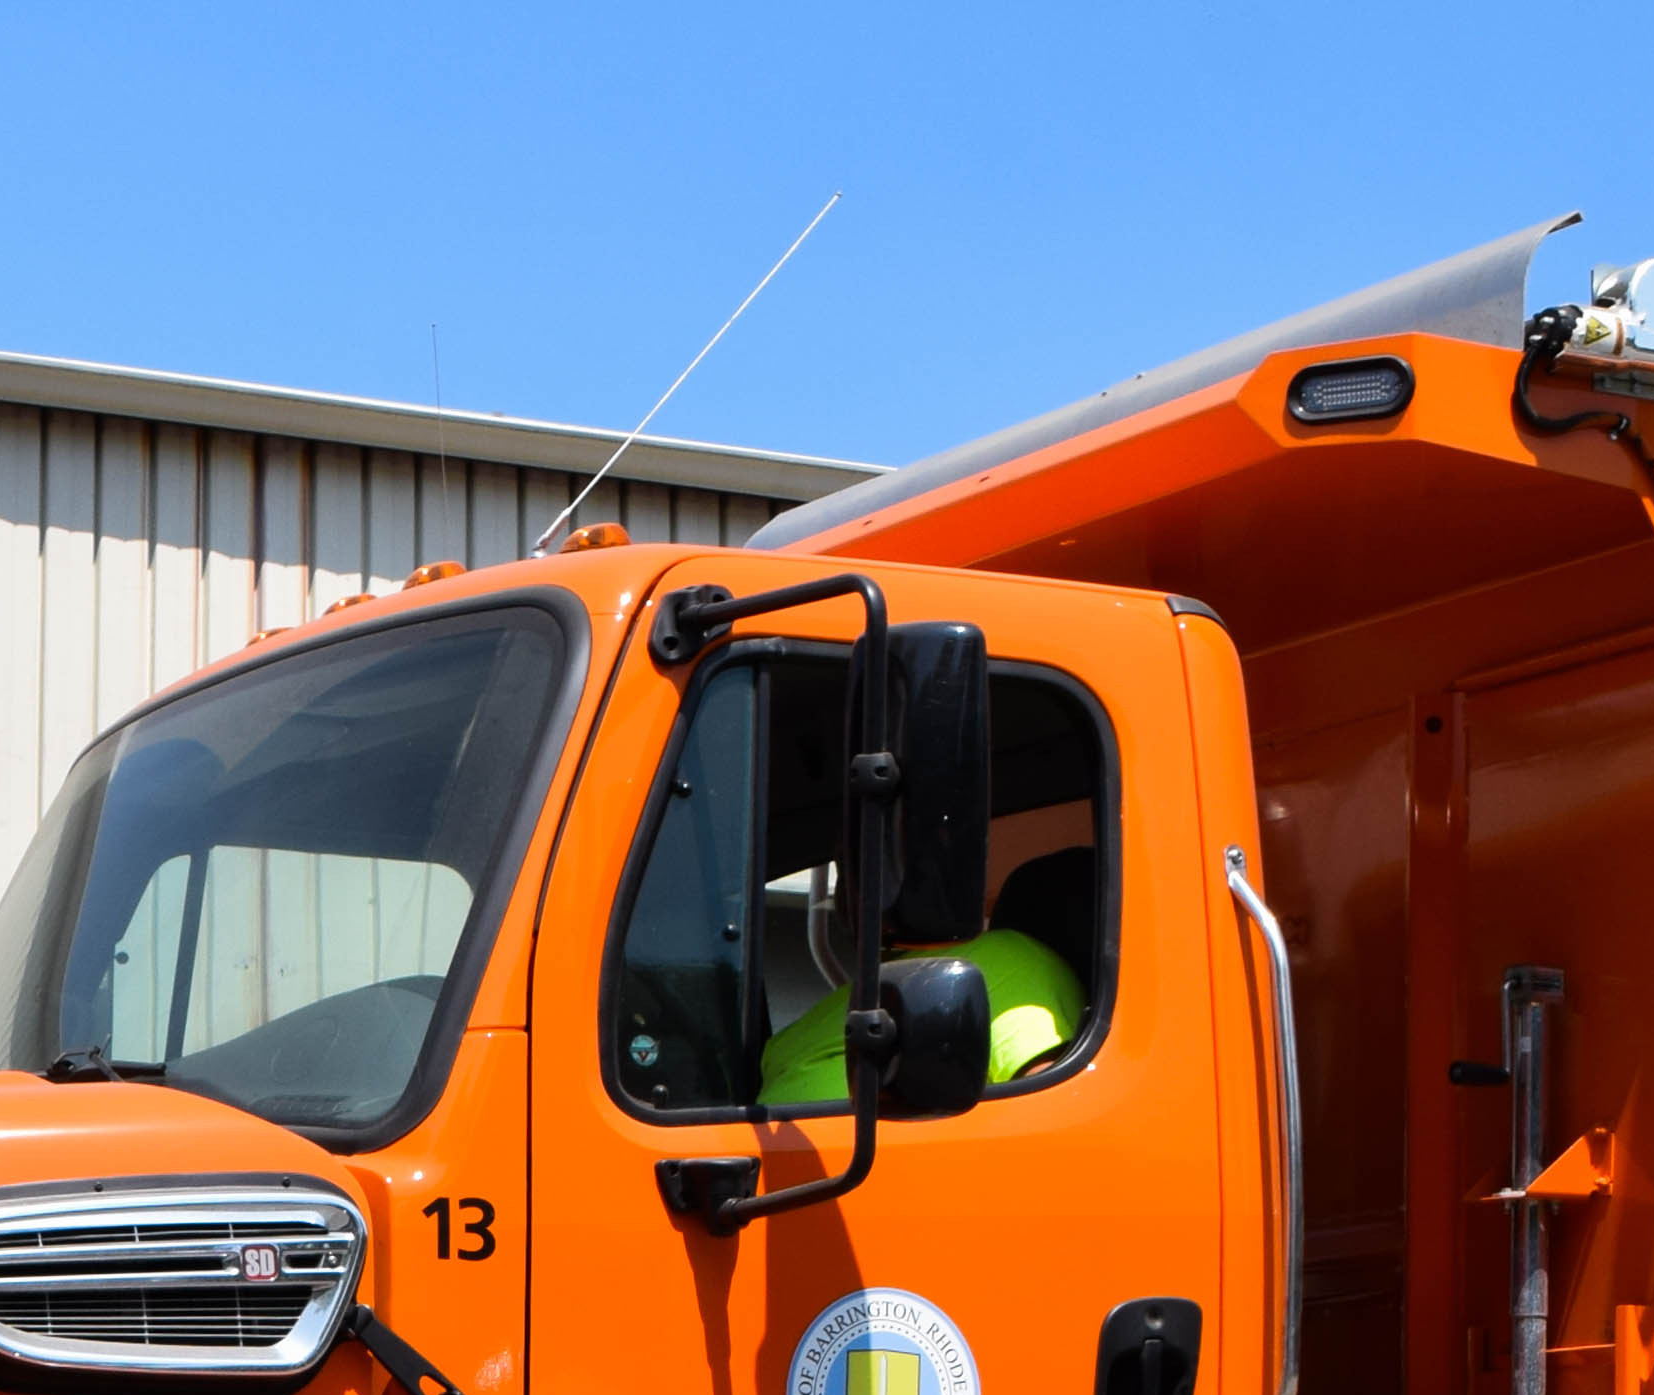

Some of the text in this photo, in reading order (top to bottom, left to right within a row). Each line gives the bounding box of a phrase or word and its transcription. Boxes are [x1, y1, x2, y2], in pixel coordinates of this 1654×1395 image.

[422, 1197, 496, 1262] 13
[245, 1248, 276, 1277] SD
[806, 1300, 922, 1366] BARRINGTON,
[926, 1322, 968, 1393] RHODE
